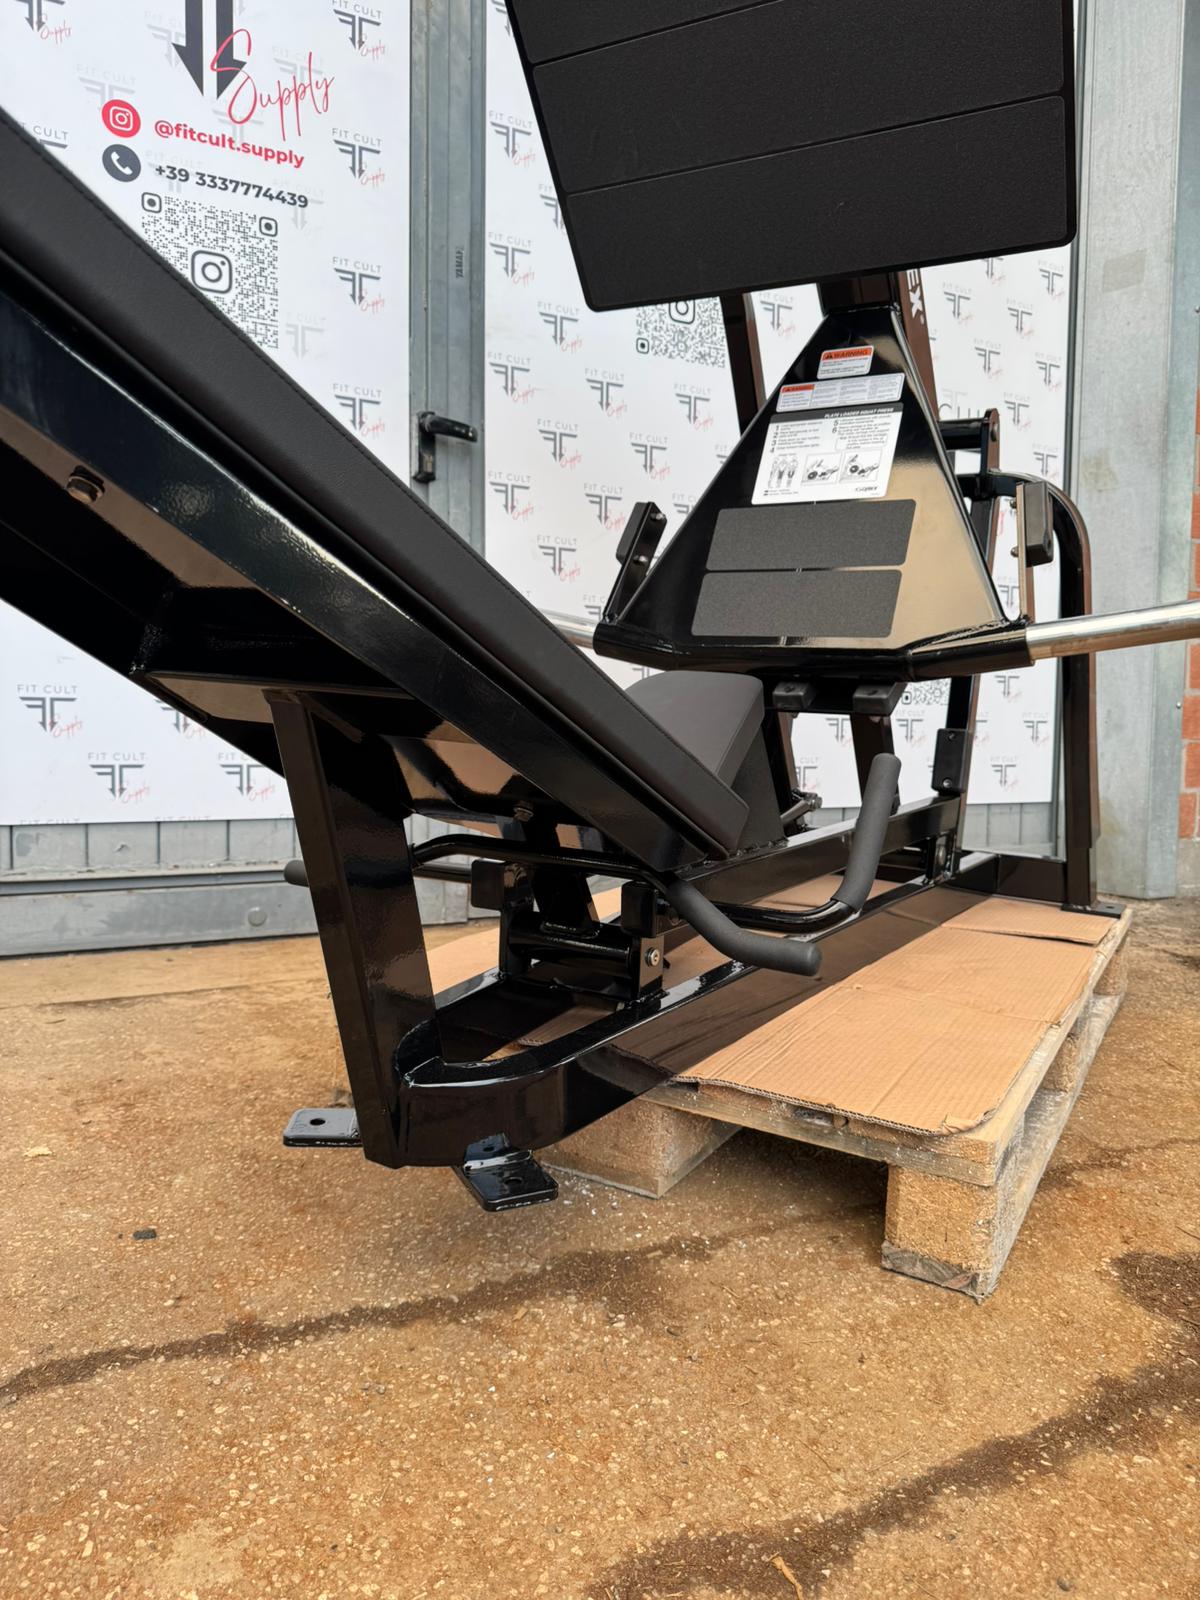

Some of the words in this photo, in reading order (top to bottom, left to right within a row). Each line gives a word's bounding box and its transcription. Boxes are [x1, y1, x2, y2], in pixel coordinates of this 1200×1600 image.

[332, 0, 348, 8] FIT
[354, 4, 382, 20] CULT
[210, 29, 334, 141] Supply
[489, 110, 504, 120] FIT
[508, 114, 533, 128] CULT
[34, 125, 69, 140] CULT
[332, 128, 348, 139] FIT
[354, 133, 382, 147] CULT
[154, 120, 304, 168] @fitcult.supply
[155, 164, 190, 183] +39
[196, 171, 308, 208] 3337774439
[538, 184, 552, 193] FIT
[488, 232, 504, 242] FIT
[508, 235, 532, 248] CULT
[332, 256, 349, 266] FIT
[354, 261, 382, 273] CULT
[537, 301, 552, 310] FIT
[556, 304, 580, 316] CULT
[488, 352, 503, 362] FIT
[506, 354, 532, 366] CULT
[585, 368, 598, 376] FIT
[602, 370, 624, 382] CULT
[333, 384, 349, 392] FIT
[354, 386, 382, 398] CULT
[674, 383, 688, 392] FIT
[691, 385, 712, 396] CULT
[537, 418, 552, 428] FIT
[555, 420, 578, 432] CULT
[630, 432, 643, 441] FIT
[646, 433, 668, 444] CULT
[488, 472, 502, 481] FIT
[506, 473, 532, 484] CULT
[584, 482, 598, 492] FIT
[600, 484, 624, 495] CULT
[537, 534, 551, 544] FIT
[554, 536, 578, 546] CULT
[583, 594, 598, 603] FIT
[18, 684, 38, 694] FIT
[44, 685, 78, 695] CULT
[88, 752, 108, 762] FIT
[113, 752, 146, 762] CULT
[218, 752, 238, 762] FIT
